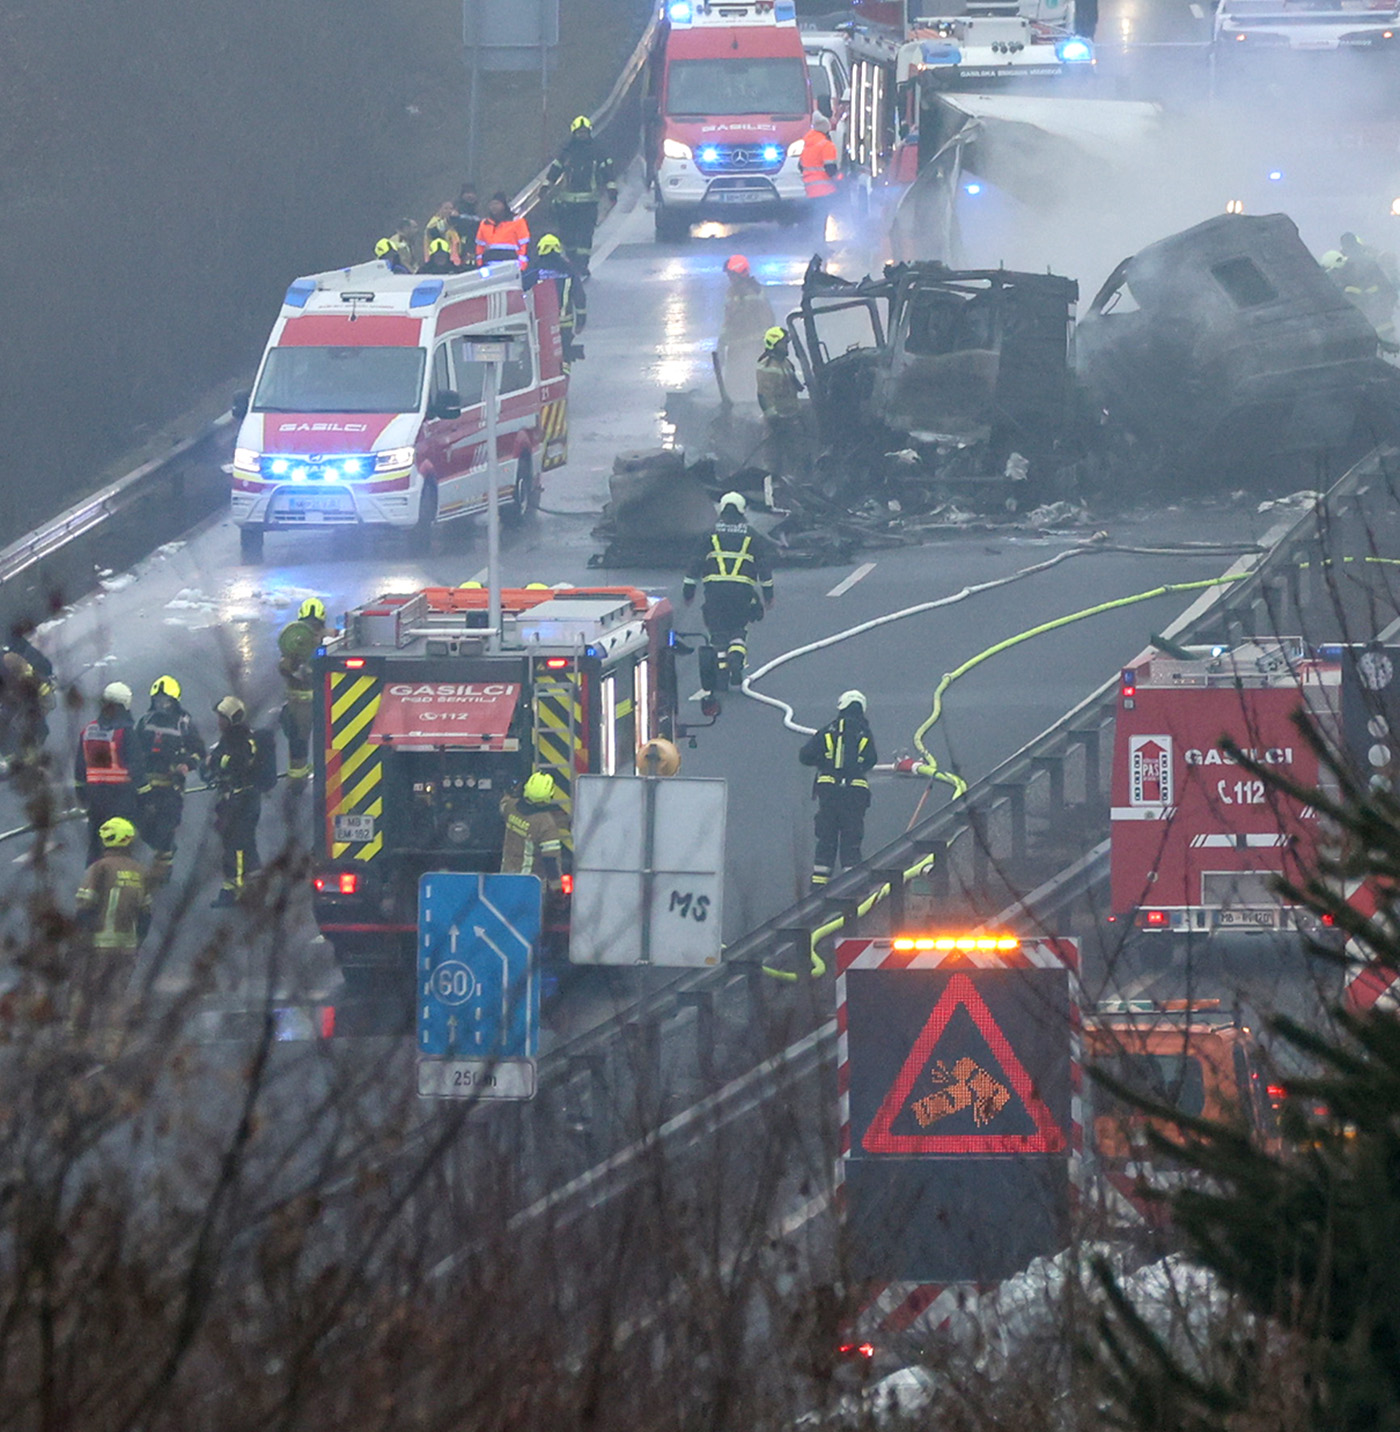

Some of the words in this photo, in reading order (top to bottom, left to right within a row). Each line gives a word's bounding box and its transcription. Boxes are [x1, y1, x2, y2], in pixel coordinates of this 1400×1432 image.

[702, 124, 776, 133] GASILCI
[279, 422, 367, 433] GASILCI
[389, 685, 514, 696] GASILCI
[1143, 763, 1159, 776] PAS
[1234, 781, 1265, 804] 112
[668, 890, 710, 922] MS
[439, 970, 468, 996] 60
